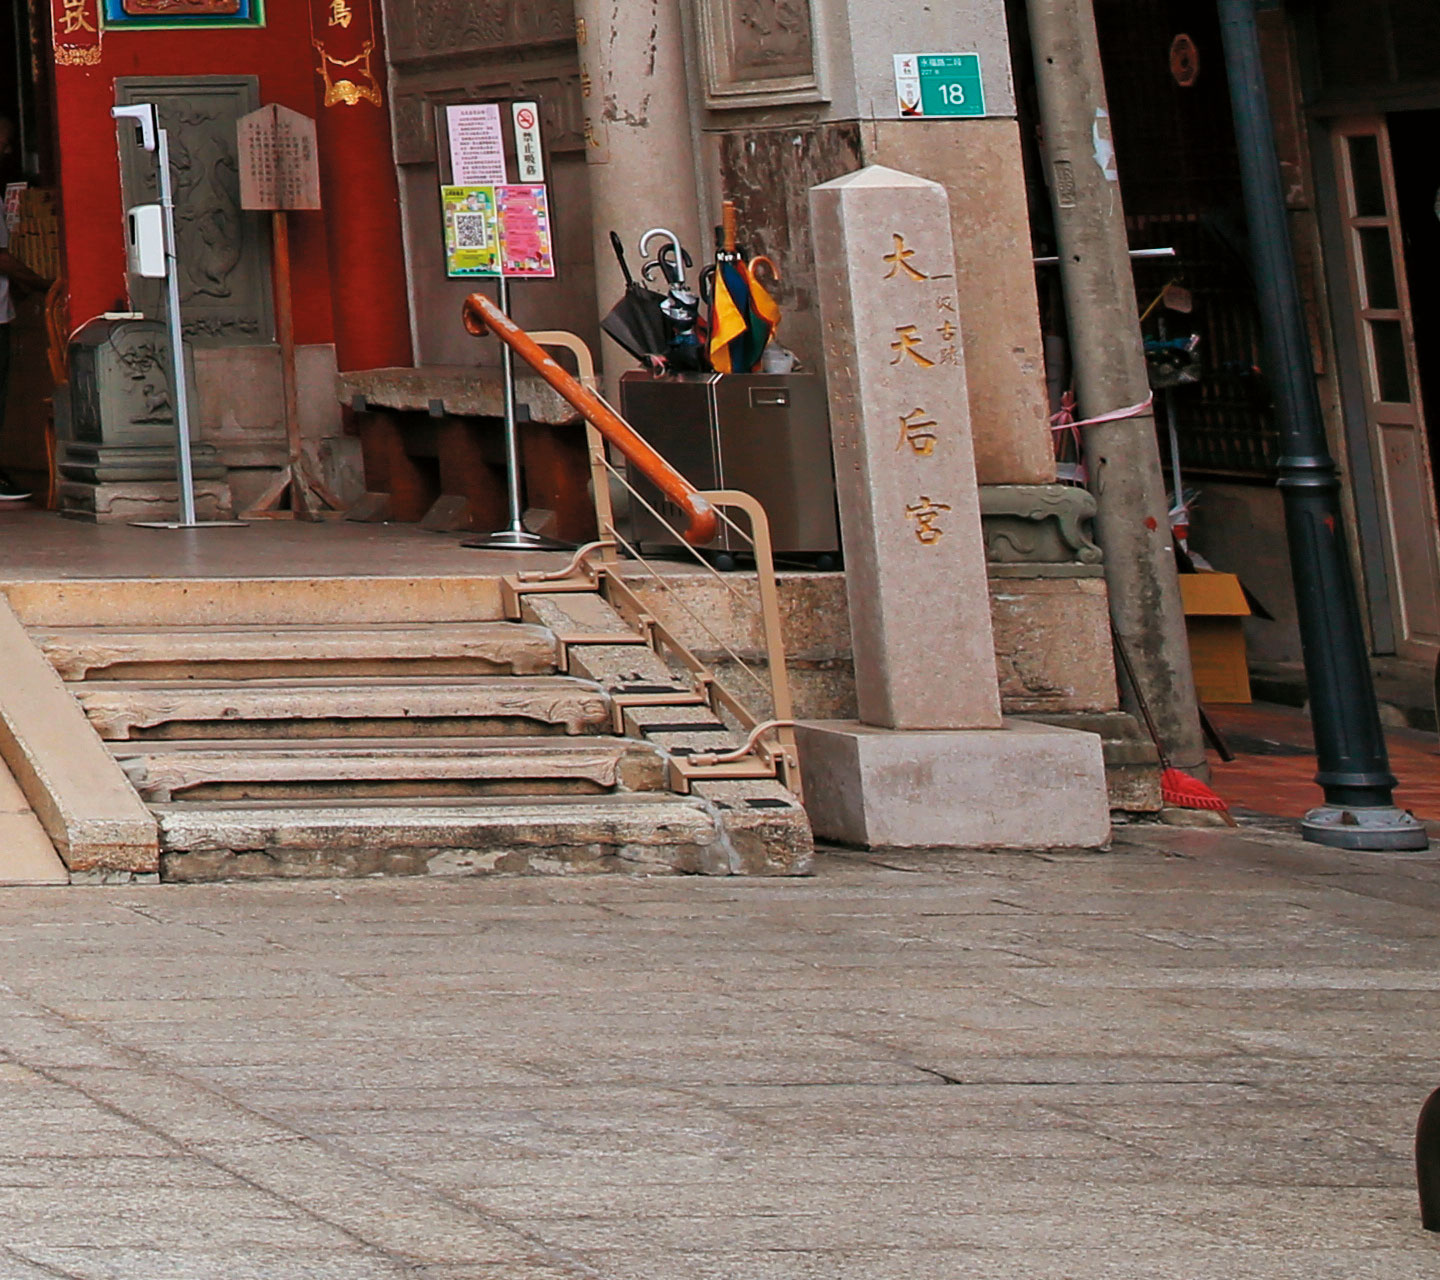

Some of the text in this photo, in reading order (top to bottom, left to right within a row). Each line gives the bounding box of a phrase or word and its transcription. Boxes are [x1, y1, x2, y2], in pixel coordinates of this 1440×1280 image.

[939, 83, 965, 105] 18
[882, 233, 952, 546] 大天后宮
